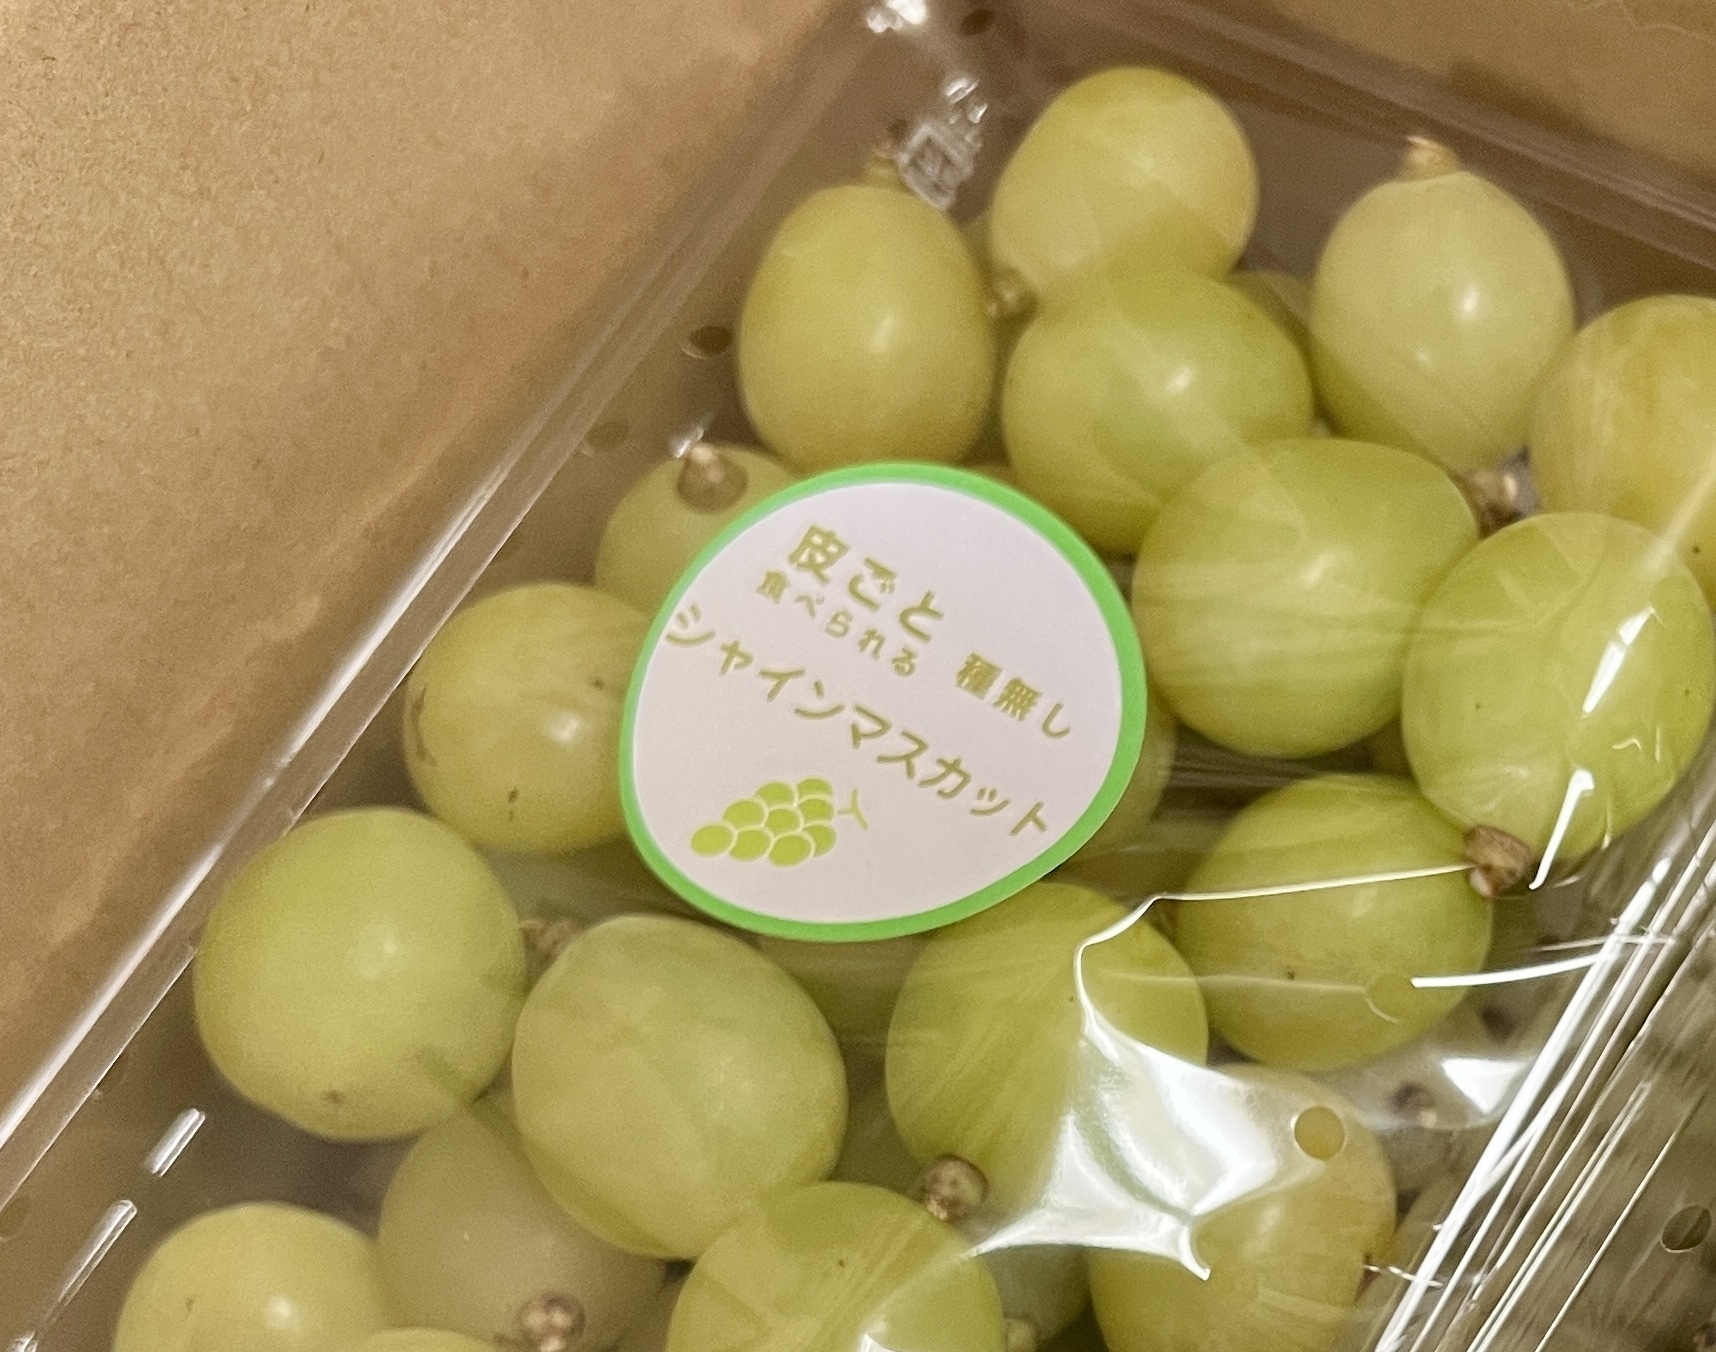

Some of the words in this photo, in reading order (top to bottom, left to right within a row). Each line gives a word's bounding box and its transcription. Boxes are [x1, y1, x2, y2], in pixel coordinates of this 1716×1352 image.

[756, 570, 917, 678] 食べられる
[788, 525, 945, 643] 皮ごと
[665, 604, 1048, 838] シャインマスカット
[954, 652, 1071, 740] 種無し
